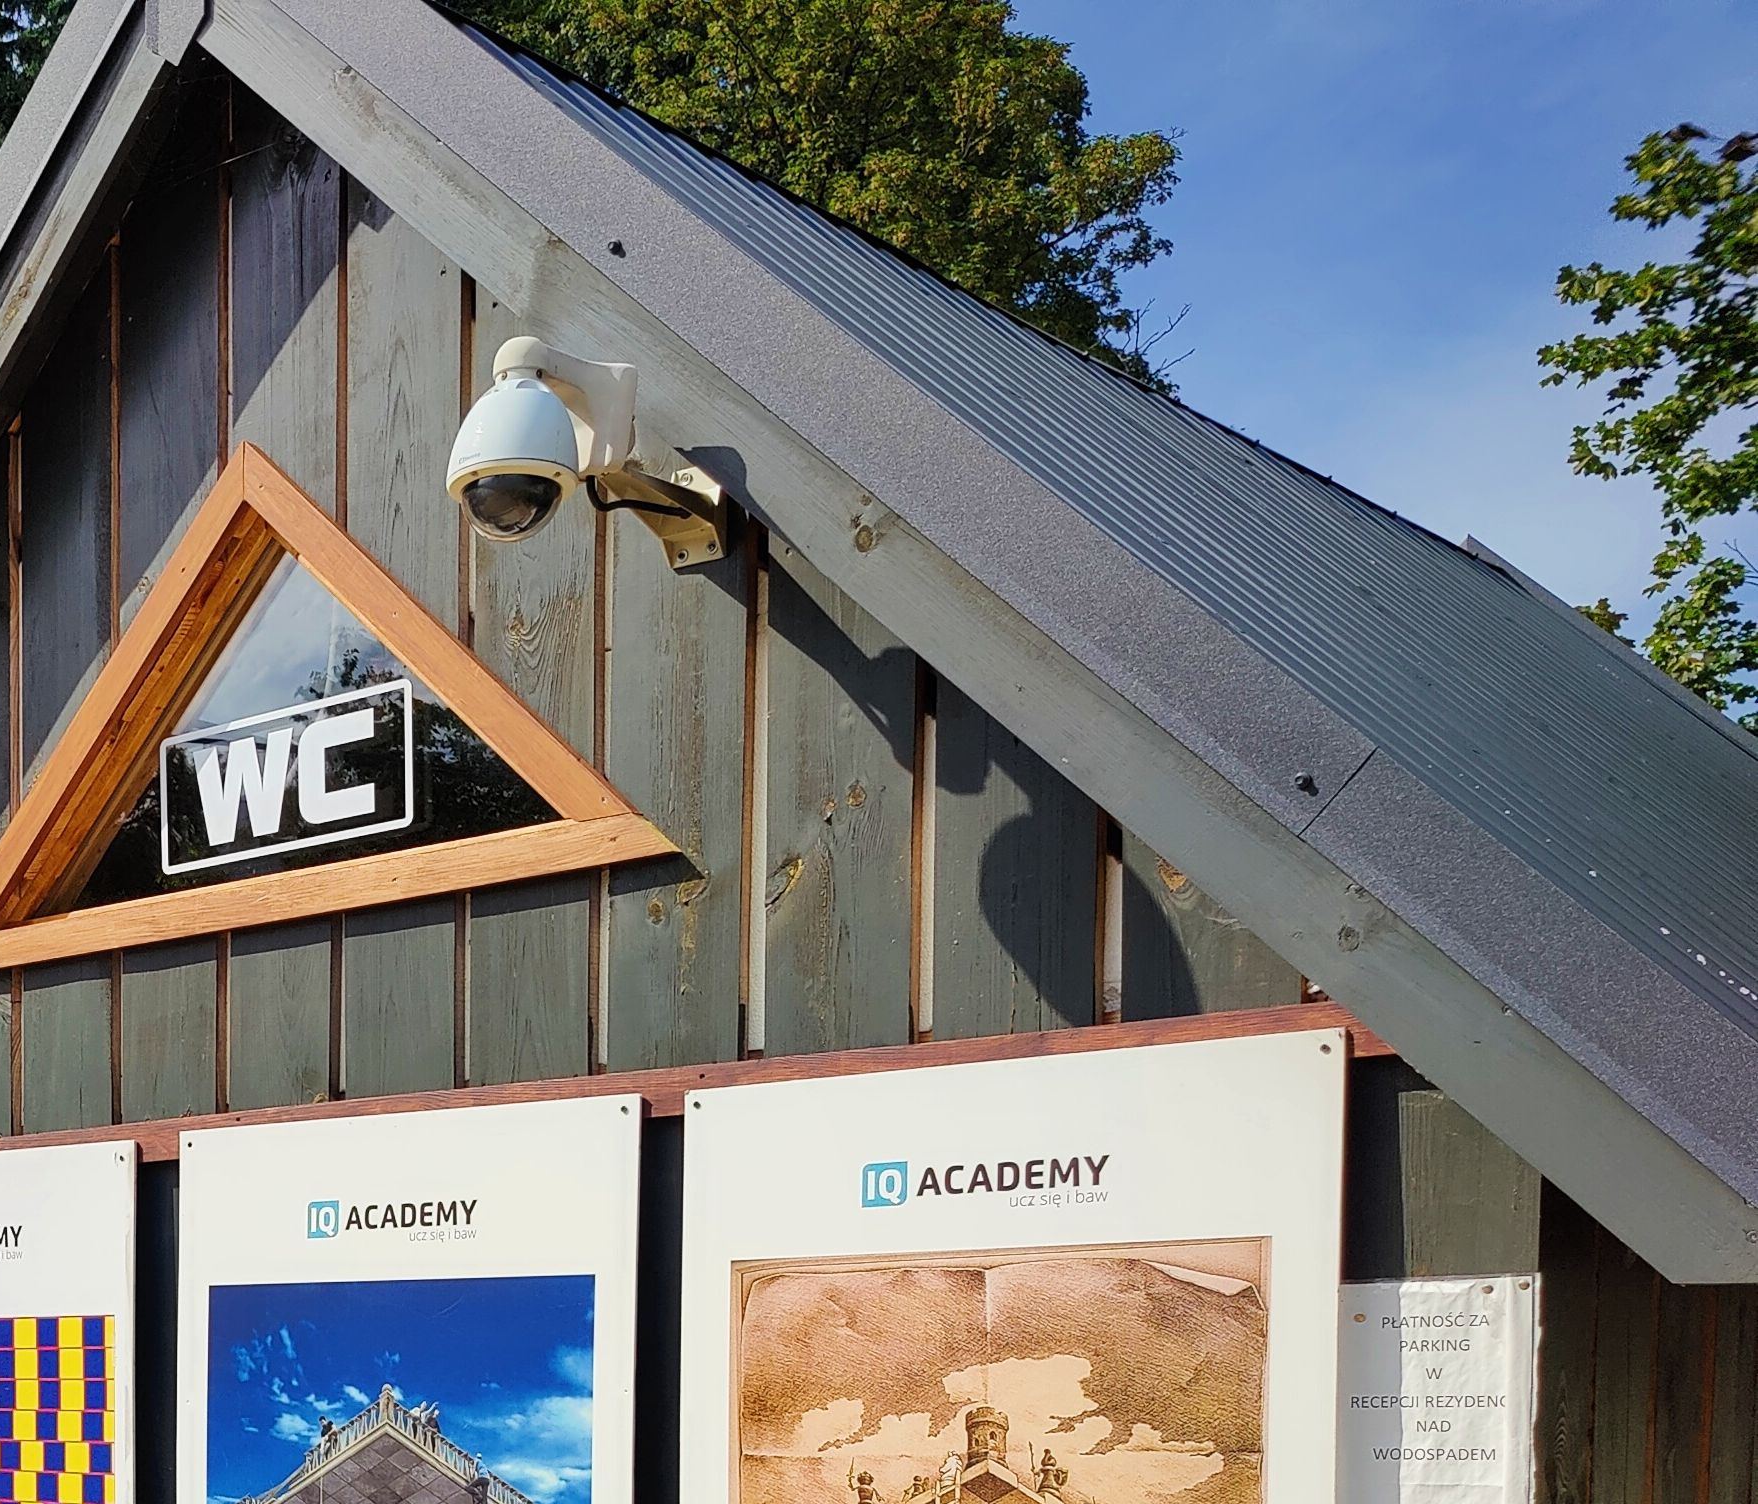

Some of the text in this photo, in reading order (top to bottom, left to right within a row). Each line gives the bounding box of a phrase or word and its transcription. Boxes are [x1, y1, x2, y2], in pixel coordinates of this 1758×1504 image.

[193, 707, 375, 847] WC
[865, 1154, 1110, 1206] IQ ACADEMY
[1009, 1194, 1034, 1208] ucz
[1040, 1191, 1061, 1208] się
[1075, 1188, 1109, 1204] baw
[309, 1199, 477, 1237] IQ ACADEMY
[409, 1231, 427, 1242] ucz
[430, 1229, 445, 1242] się
[454, 1228, 477, 1239] baw
[1381, 1312, 1490, 1329] PŁATNOŚĆ ZA
[1399, 1339, 1471, 1352] PARKING
[1425, 1367, 1443, 1380] W
[1350, 1396, 1419, 1408] RECEPCJI
[1416, 1420, 1452, 1433] NAD
[1373, 1448, 1496, 1461] WODOSPADEM
